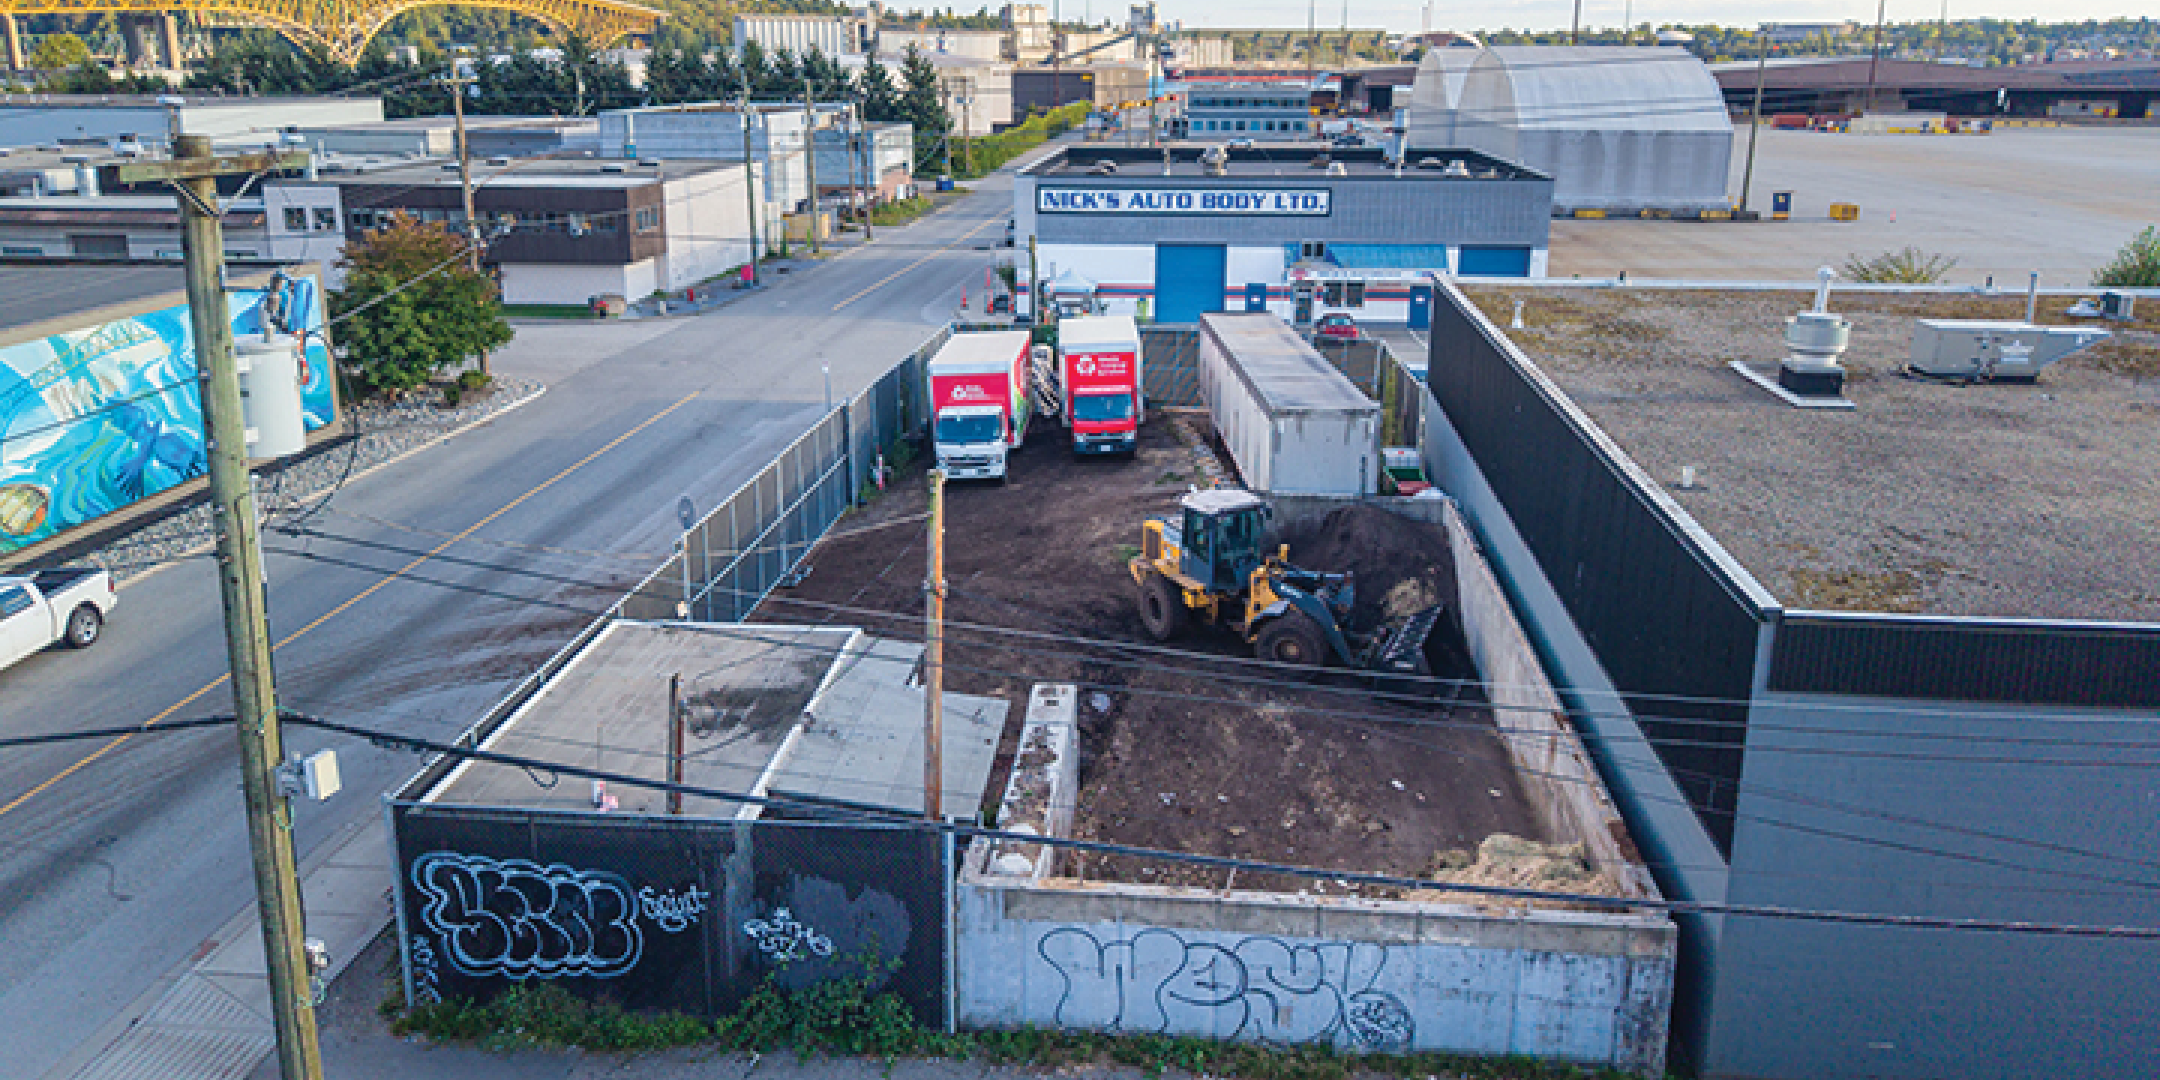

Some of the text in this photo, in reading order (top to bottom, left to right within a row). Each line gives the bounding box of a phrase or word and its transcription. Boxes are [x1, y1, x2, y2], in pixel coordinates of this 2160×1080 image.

[1043, 192, 1327, 210] NICK'S AUTO BODY LTD.
